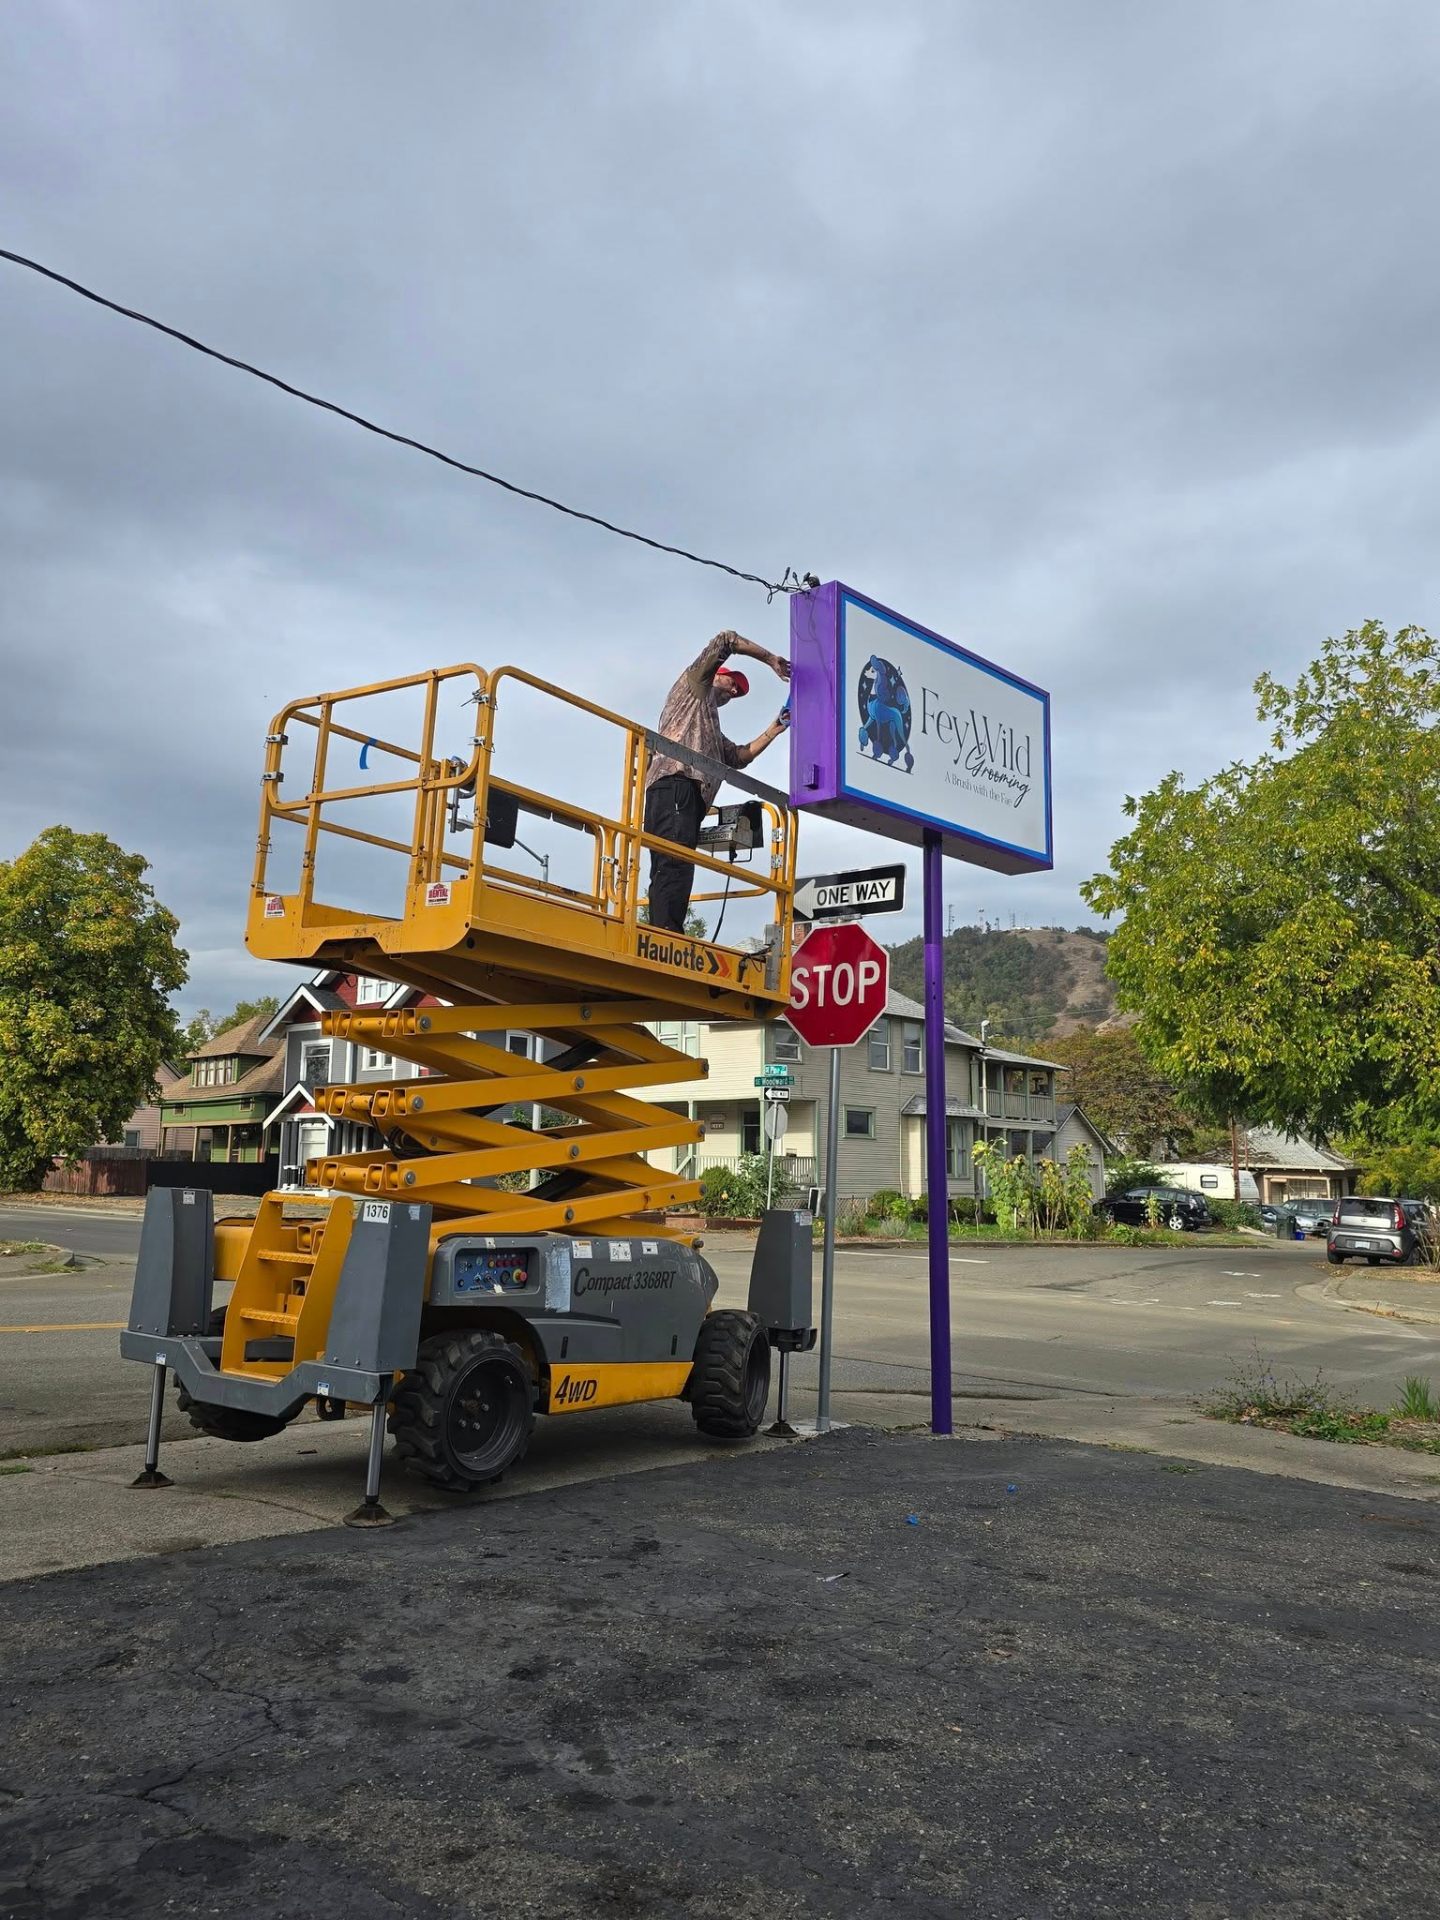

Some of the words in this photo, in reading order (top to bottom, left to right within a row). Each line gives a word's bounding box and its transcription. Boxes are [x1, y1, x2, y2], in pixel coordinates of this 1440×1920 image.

[944, 771, 951, 784] A
[952, 774, 972, 792] Brush
[965, 742, 1031, 808] Grooming
[817, 886, 849, 906] ONE
[855, 880, 890, 902] WAY
[637, 934, 705, 972] Haulotte
[790, 960, 880, 1010] STOP
[366, 1204, 389, 1219] 1376
[573, 1267, 633, 1297] Compact
[633, 1271, 677, 1289] 3368RT
[555, 1375, 597, 1405] 4WD
